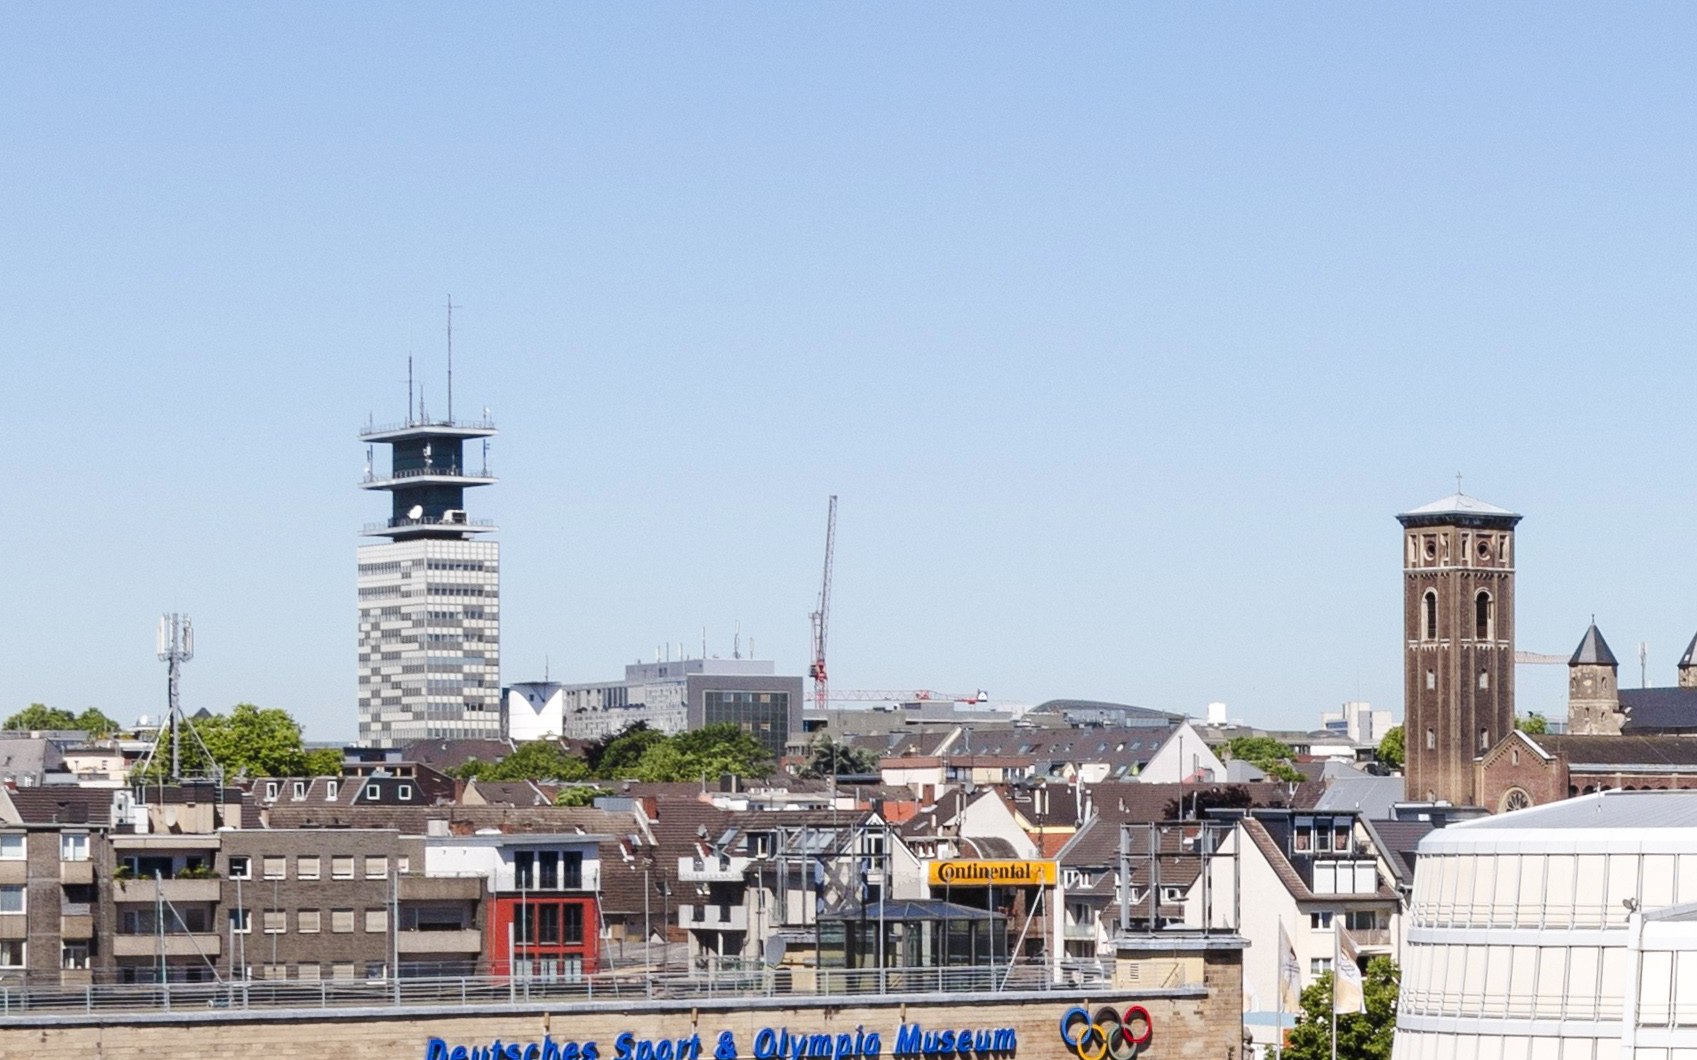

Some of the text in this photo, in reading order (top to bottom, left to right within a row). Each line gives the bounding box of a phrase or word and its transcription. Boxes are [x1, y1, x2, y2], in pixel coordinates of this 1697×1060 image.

[938, 862, 1030, 883] Continental
[715, 1030, 737, 1060] &
[895, 1021, 1017, 1055] Museum
